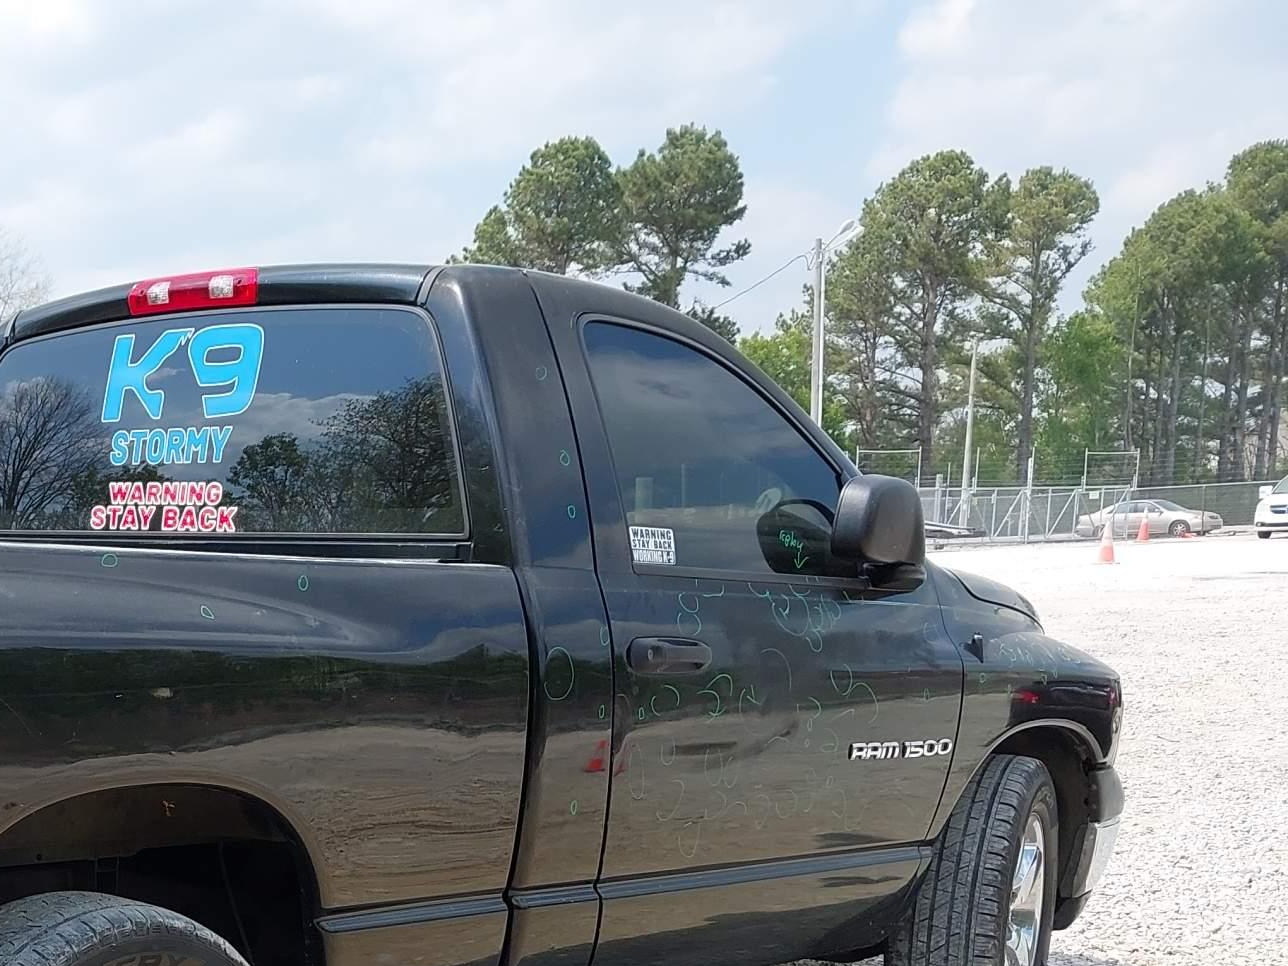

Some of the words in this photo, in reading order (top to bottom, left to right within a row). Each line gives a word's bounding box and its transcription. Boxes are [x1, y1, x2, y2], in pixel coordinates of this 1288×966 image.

[101, 323, 265, 423] K9
[110, 426, 233, 465] STORMY
[109, 482, 224, 506] WARNING
[90, 505, 157, 531] STAY
[161, 506, 239, 532] BACK
[631, 527, 671, 540] WARNING
[632, 538, 650, 549] STAY
[654, 540, 672, 550] BACK
[632, 549, 662, 562] WORKING
[850, 742, 900, 761] RAM
[903, 738, 953, 758] 1500
